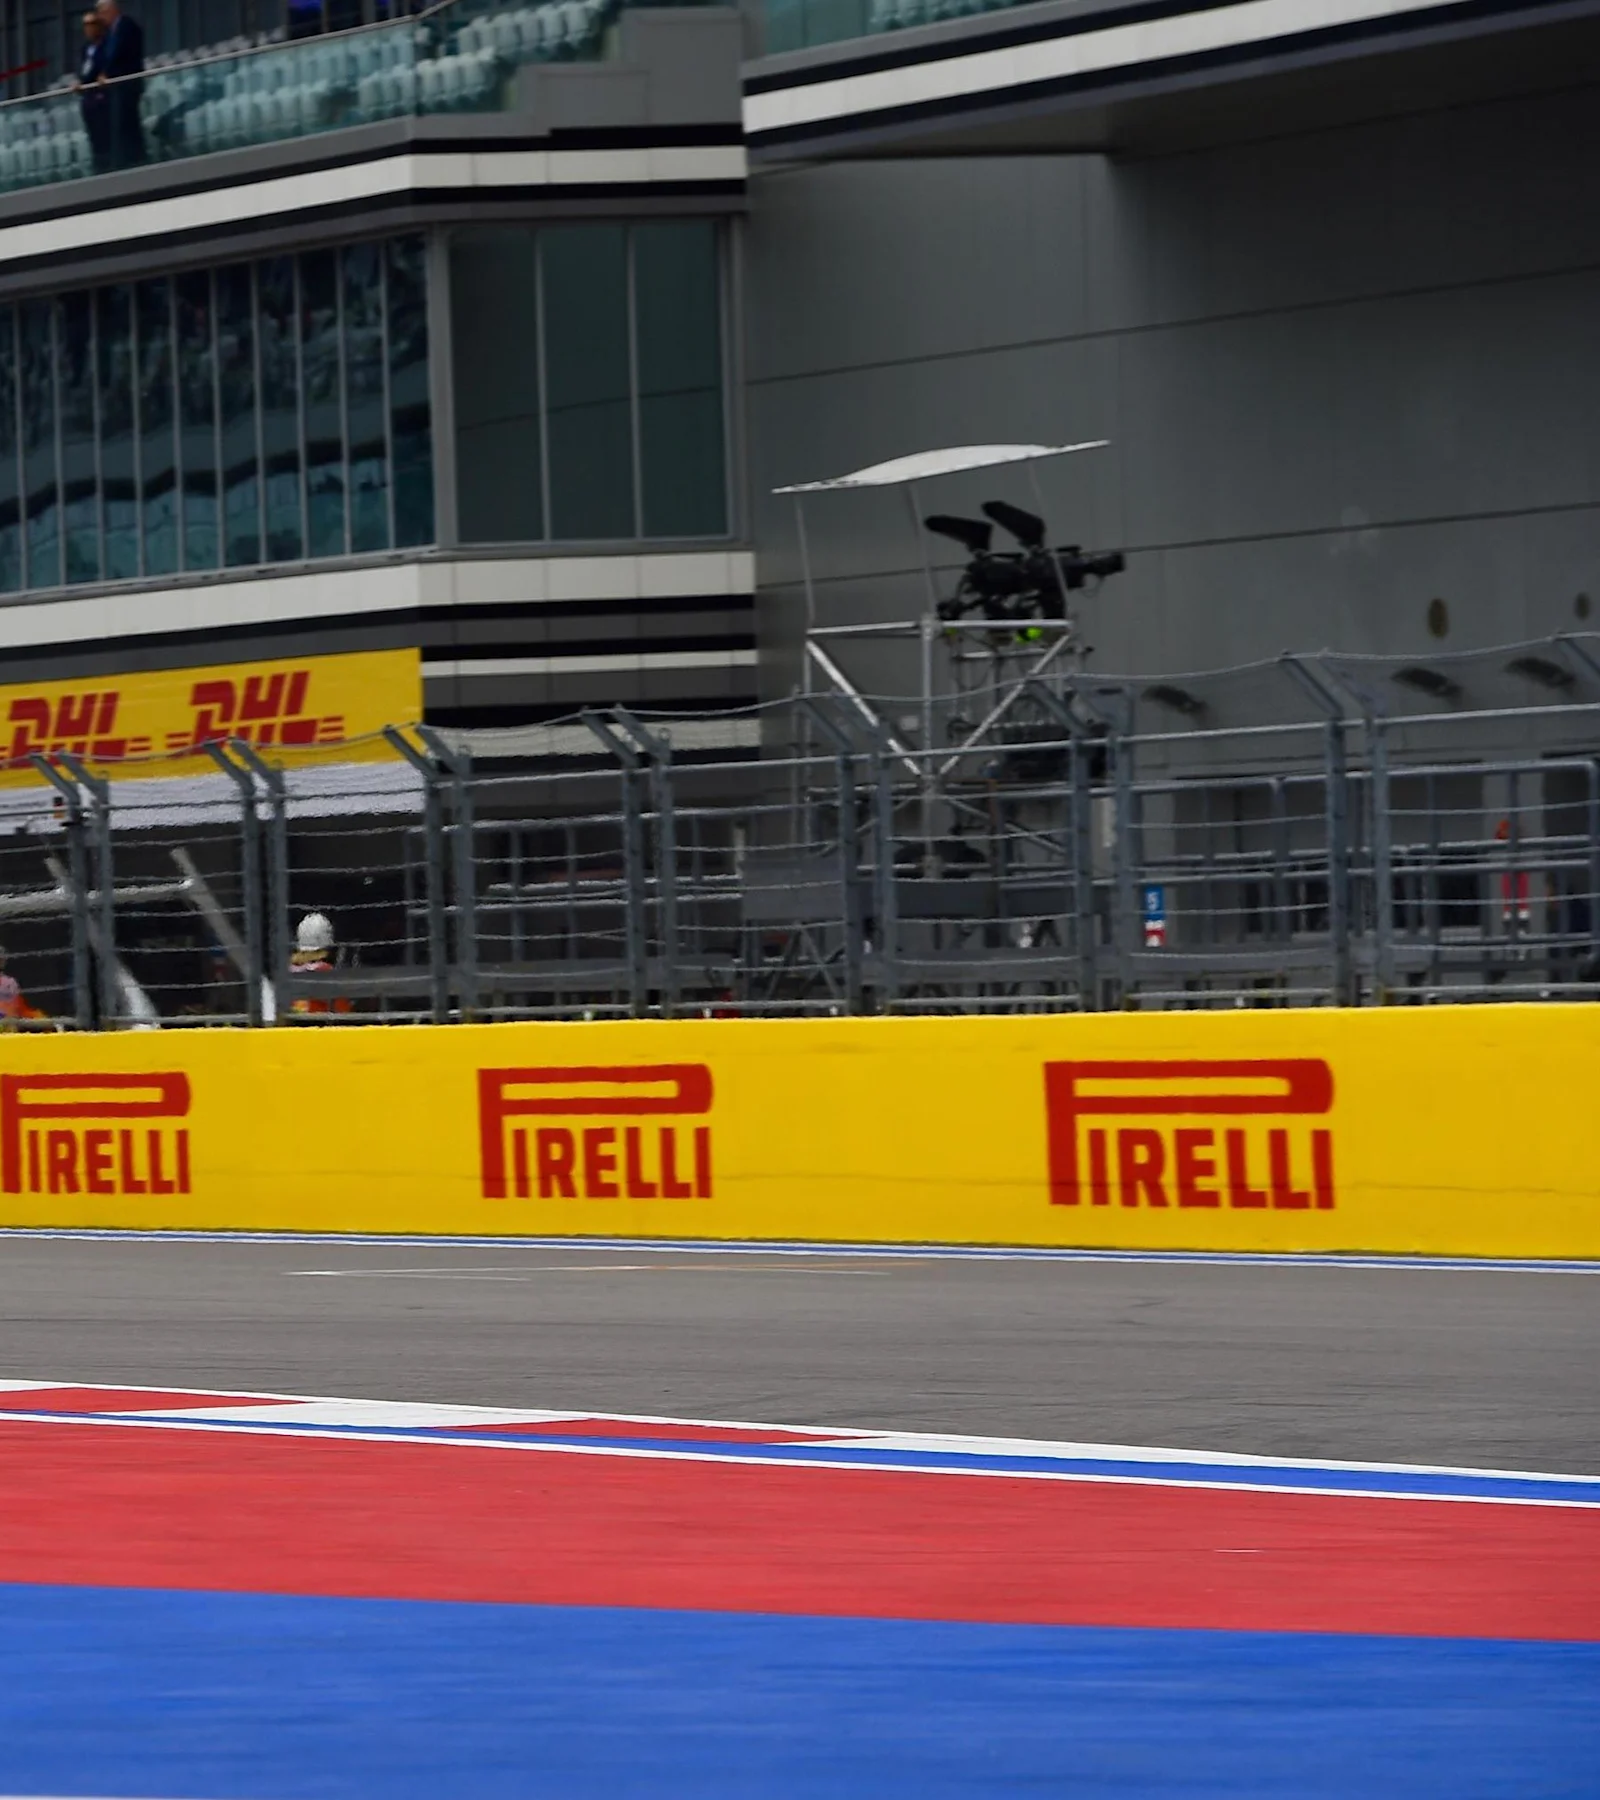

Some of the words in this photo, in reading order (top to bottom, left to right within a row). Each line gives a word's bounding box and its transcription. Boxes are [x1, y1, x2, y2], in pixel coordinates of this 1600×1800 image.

[9, 692, 125, 766] DHL
[191, 671, 319, 750] DHL
[0, 1072, 191, 1194] PIRELLI
[479, 1065, 714, 1199] PIRELLI
[1045, 1059, 1333, 1209] PIRELLI
